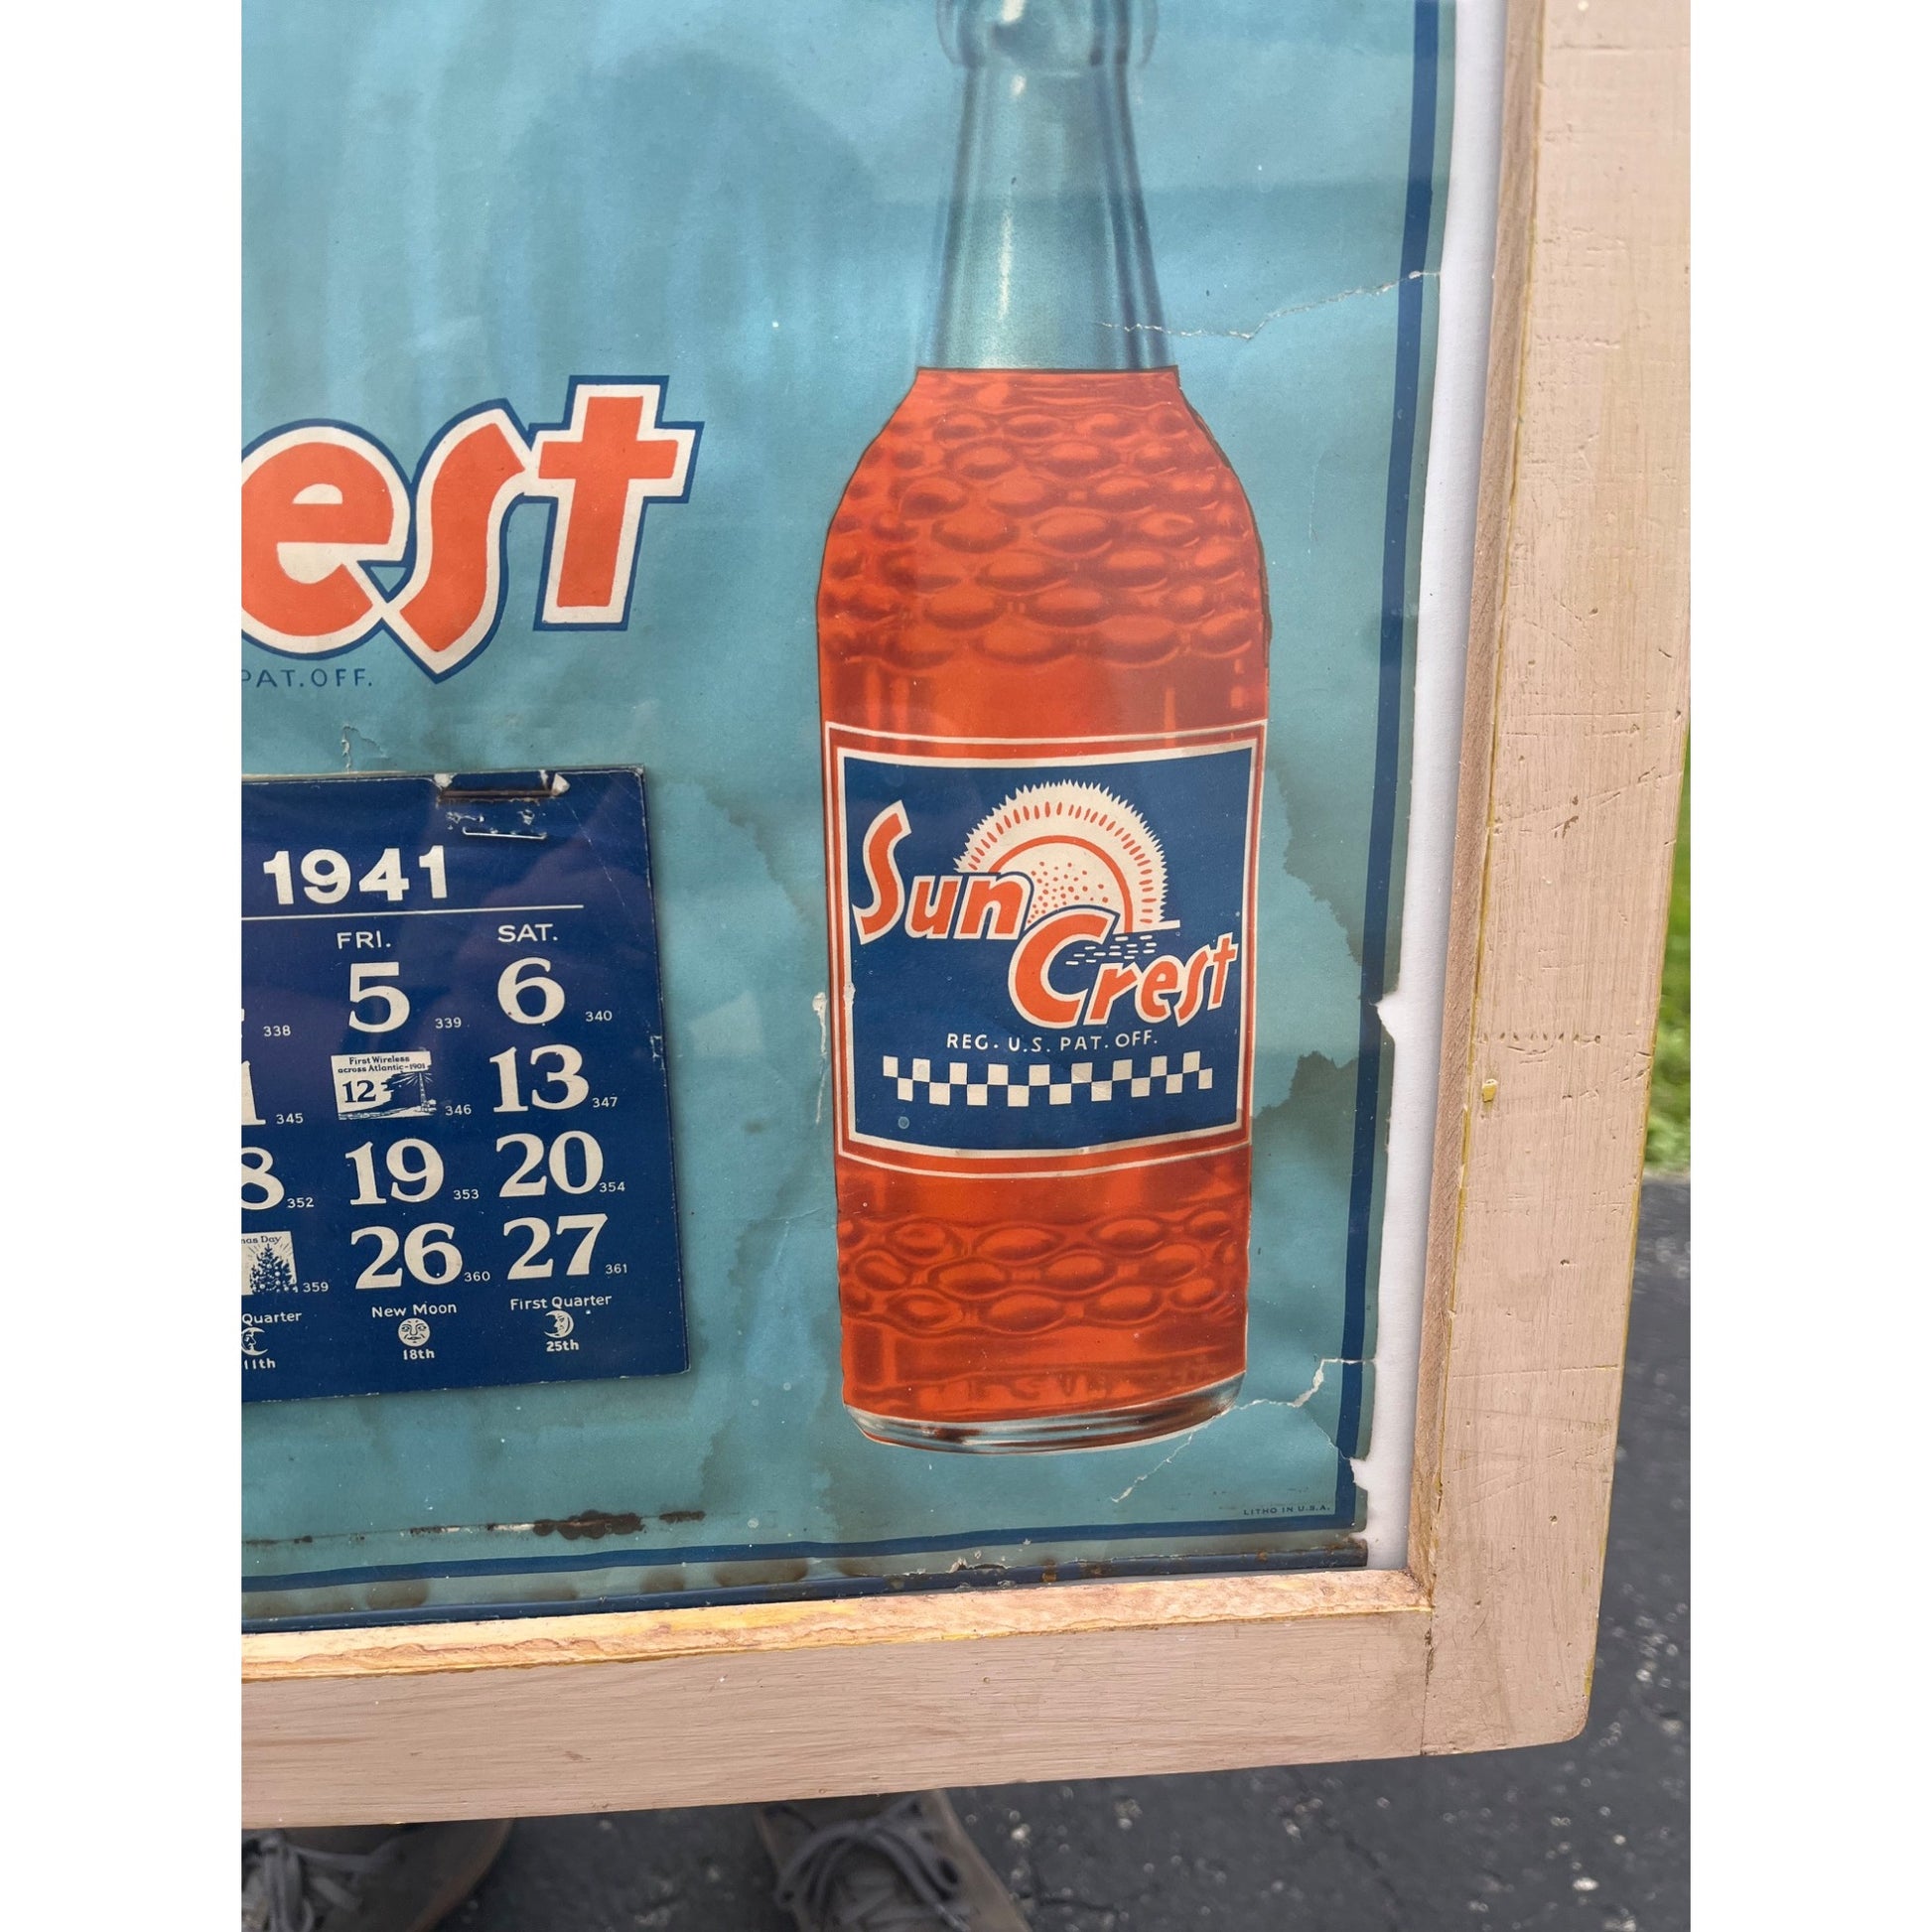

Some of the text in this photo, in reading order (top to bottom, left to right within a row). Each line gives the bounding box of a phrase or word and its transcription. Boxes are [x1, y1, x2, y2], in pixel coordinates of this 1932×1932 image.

[263, 846, 447, 904] 1941
[852, 800, 1033, 944] Sun
[337, 930, 391, 949] FRI.
[497, 923, 558, 943] SAT.
[1008, 908, 1239, 1030] Crest
[348, 961, 410, 1034] 5
[497, 957, 565, 1025] 6
[586, 1010, 613, 1023] 340
[263, 1025, 291, 1036] 338
[435, 1018, 462, 1030] 339
[946, 1033, 999, 1050] REG.
[1060, 1035, 1109, 1051] PAT.
[1115, 1030, 1158, 1048] OFF.
[349, 1056, 370, 1065] First
[489, 1044, 589, 1112] 13
[343, 1079, 376, 1103] 12
[592, 1097, 618, 1108] 347
[445, 1104, 472, 1116] 346
[276, 1113, 304, 1124] 345
[496, 1130, 604, 1197] 20
[345, 1138, 444, 1205] 19
[599, 1181, 625, 1192] 354
[453, 1189, 480, 1200] 353
[287, 1197, 314, 1208] 352
[260, 1236, 282, 1245] Day
[503, 1213, 608, 1280] 27
[350, 1222, 463, 1290] 26
[605, 1264, 627, 1275] 361
[464, 1271, 490, 1282] 360
[303, 1282, 329, 1293] 359
[510, 1296, 612, 1311] First Quarter
[371, 1304, 457, 1318] New Moon
[242, 1311, 302, 1326] Quarter
[546, 1339, 579, 1351] 25th
[402, 1349, 435, 1360] 18th
[243, 1357, 276, 1370] 11th
[1243, 1507, 1278, 1516] LITHO
